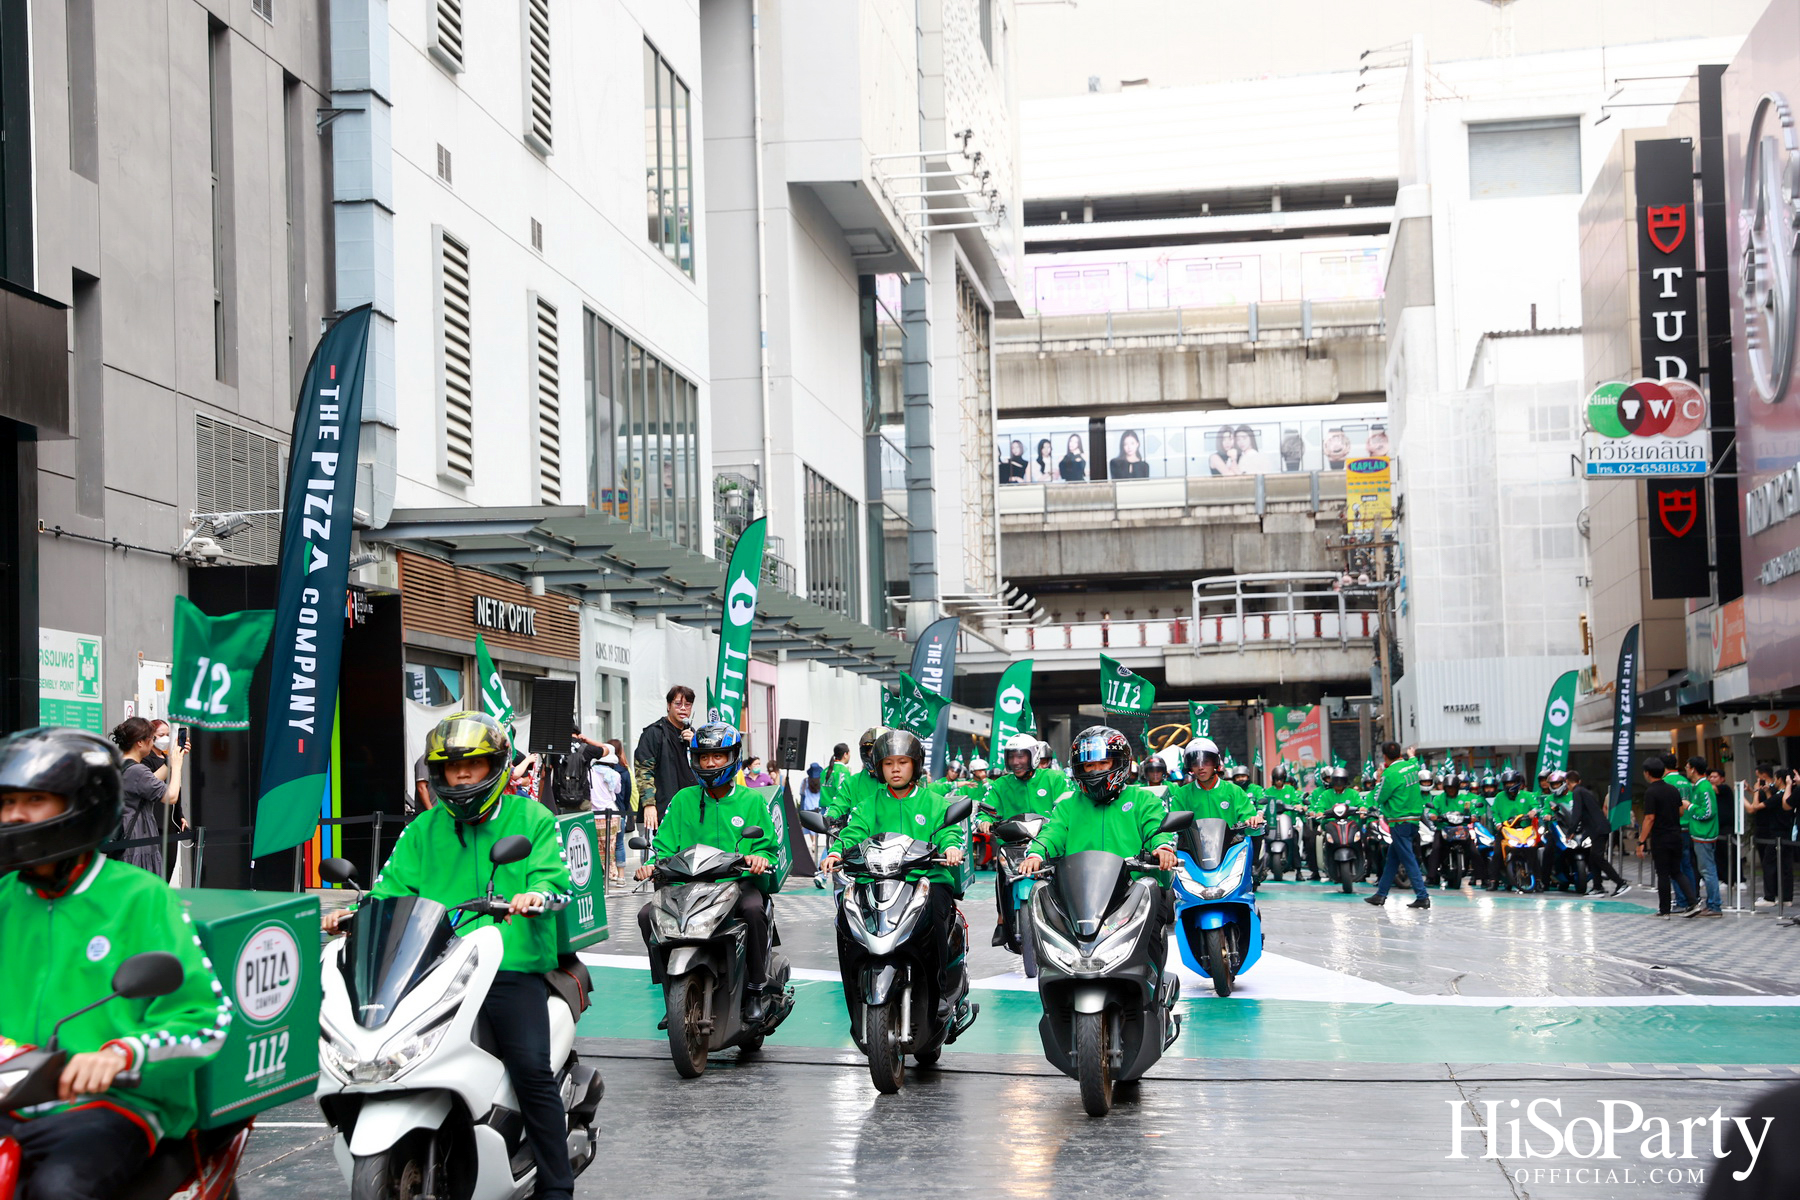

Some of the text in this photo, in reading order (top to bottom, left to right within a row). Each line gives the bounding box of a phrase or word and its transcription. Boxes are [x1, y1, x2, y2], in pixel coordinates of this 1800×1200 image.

[1652, 267, 1687, 380] TUD
[1588, 394, 1619, 406] clinic
[1587, 440, 1704, 461] ทวีชัยคลินิก
[1350, 460, 1387, 472] KAPLAN
[288, 384, 340, 735] THE PIZZA COMPANY
[927, 643, 942, 665] THE
[60, 680, 75, 691] POINT
[1106, 679, 1141, 709] 1112
[1443, 703, 1480, 713] MASSAGE
[1617, 653, 1632, 787] THE PIZZA COMPANY
[569, 843, 588, 870] PIZZA
[577, 895, 594, 924] 1112
[262, 938, 274, 951] THE
[245, 950, 291, 998] PIZZA
[255, 992, 282, 1011] COMPANY
[244, 1030, 290, 1083] 1112
